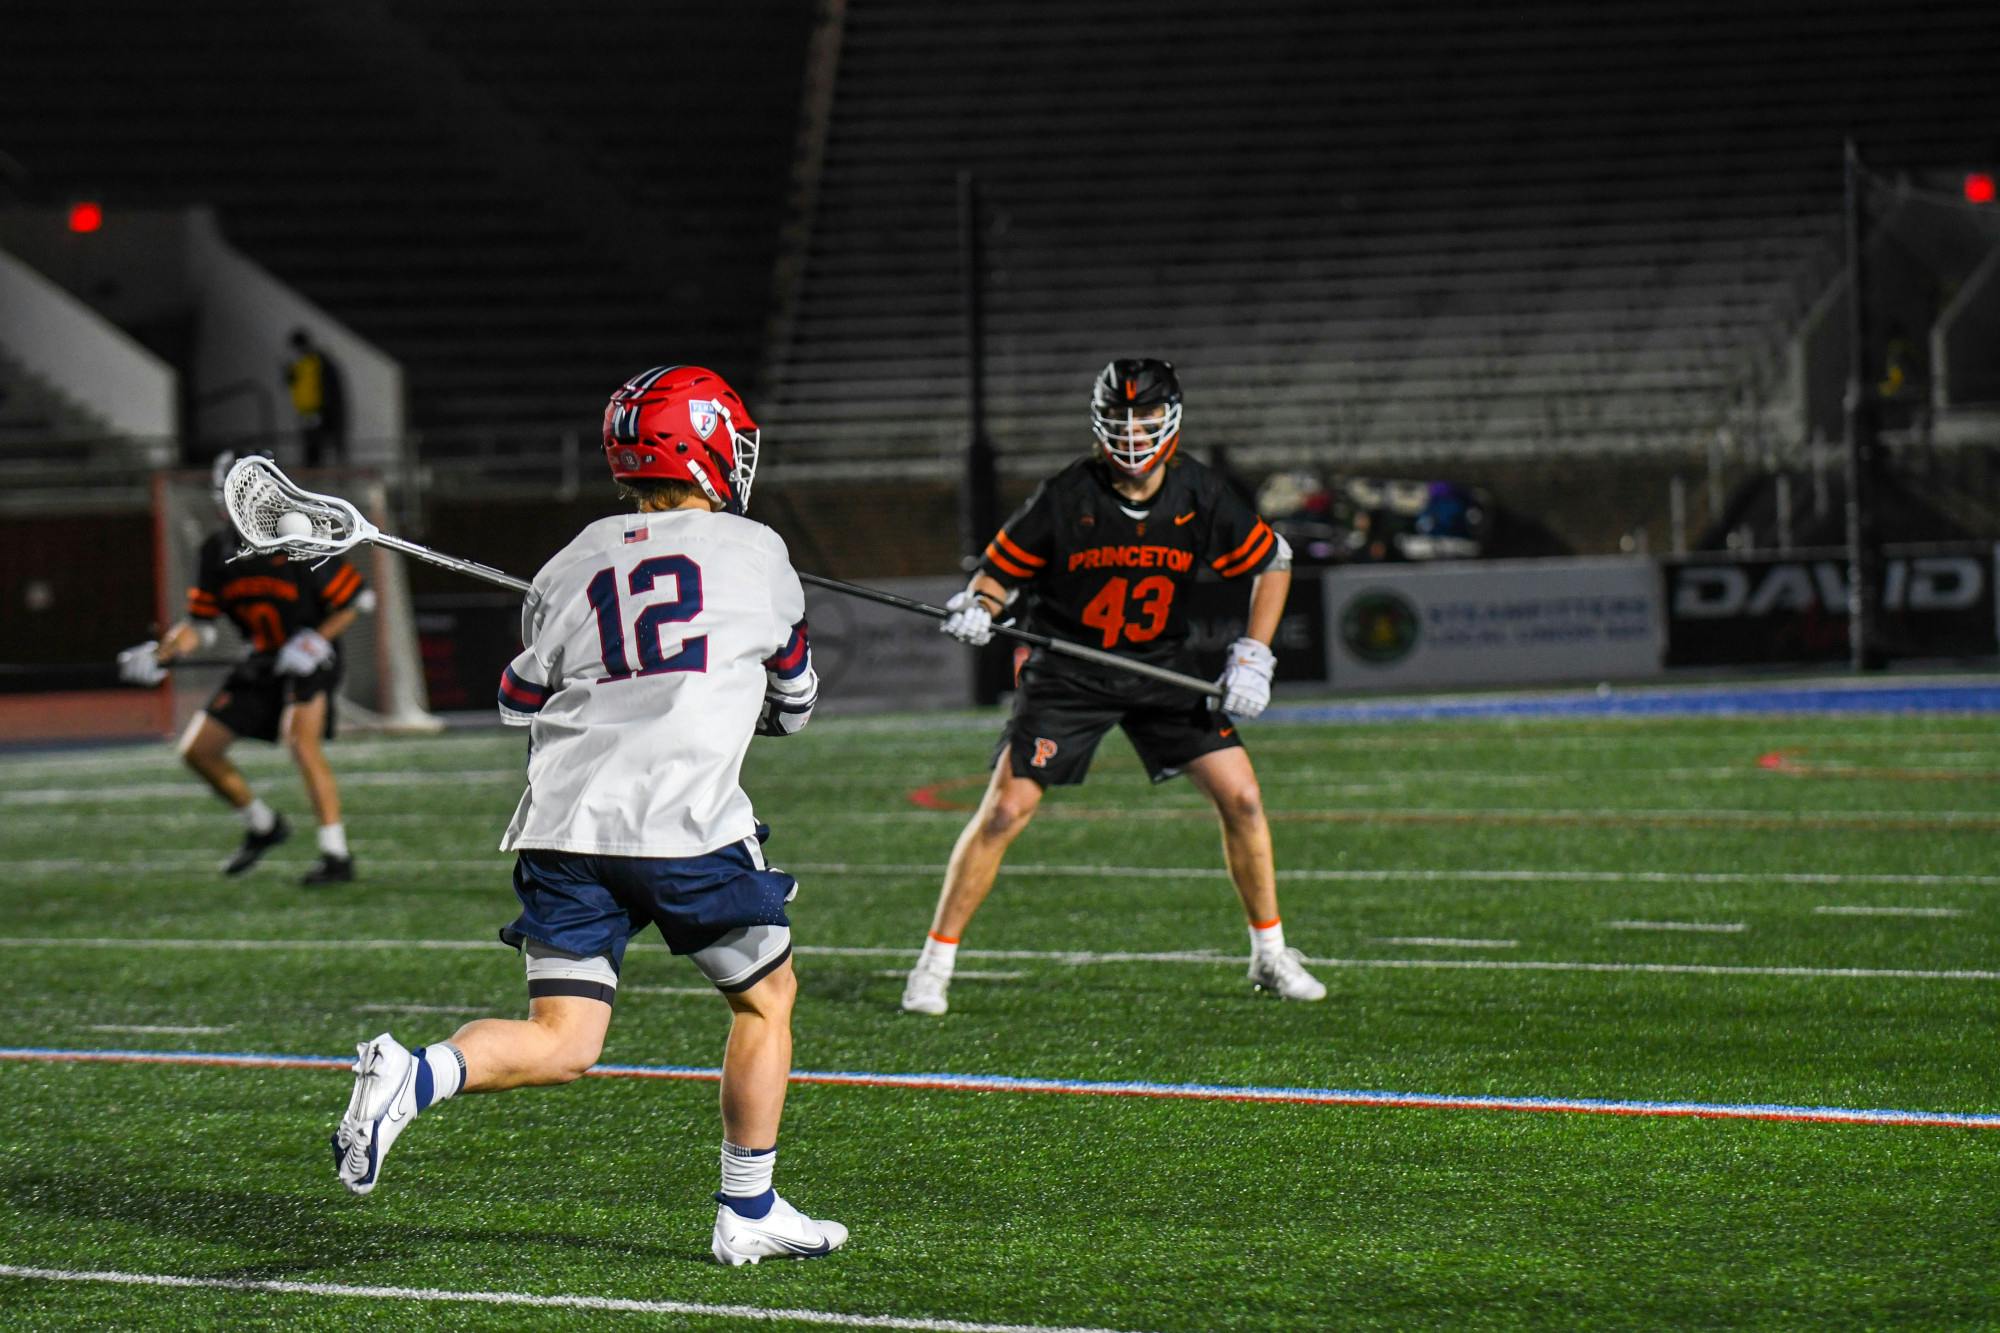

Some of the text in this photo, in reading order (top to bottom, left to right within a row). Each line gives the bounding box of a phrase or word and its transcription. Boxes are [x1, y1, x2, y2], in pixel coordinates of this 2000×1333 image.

[1068, 545, 1195, 572] PRINCETON
[586, 554, 708, 684] 12
[1082, 575, 1175, 648] 43
[1031, 737, 1058, 768] P
